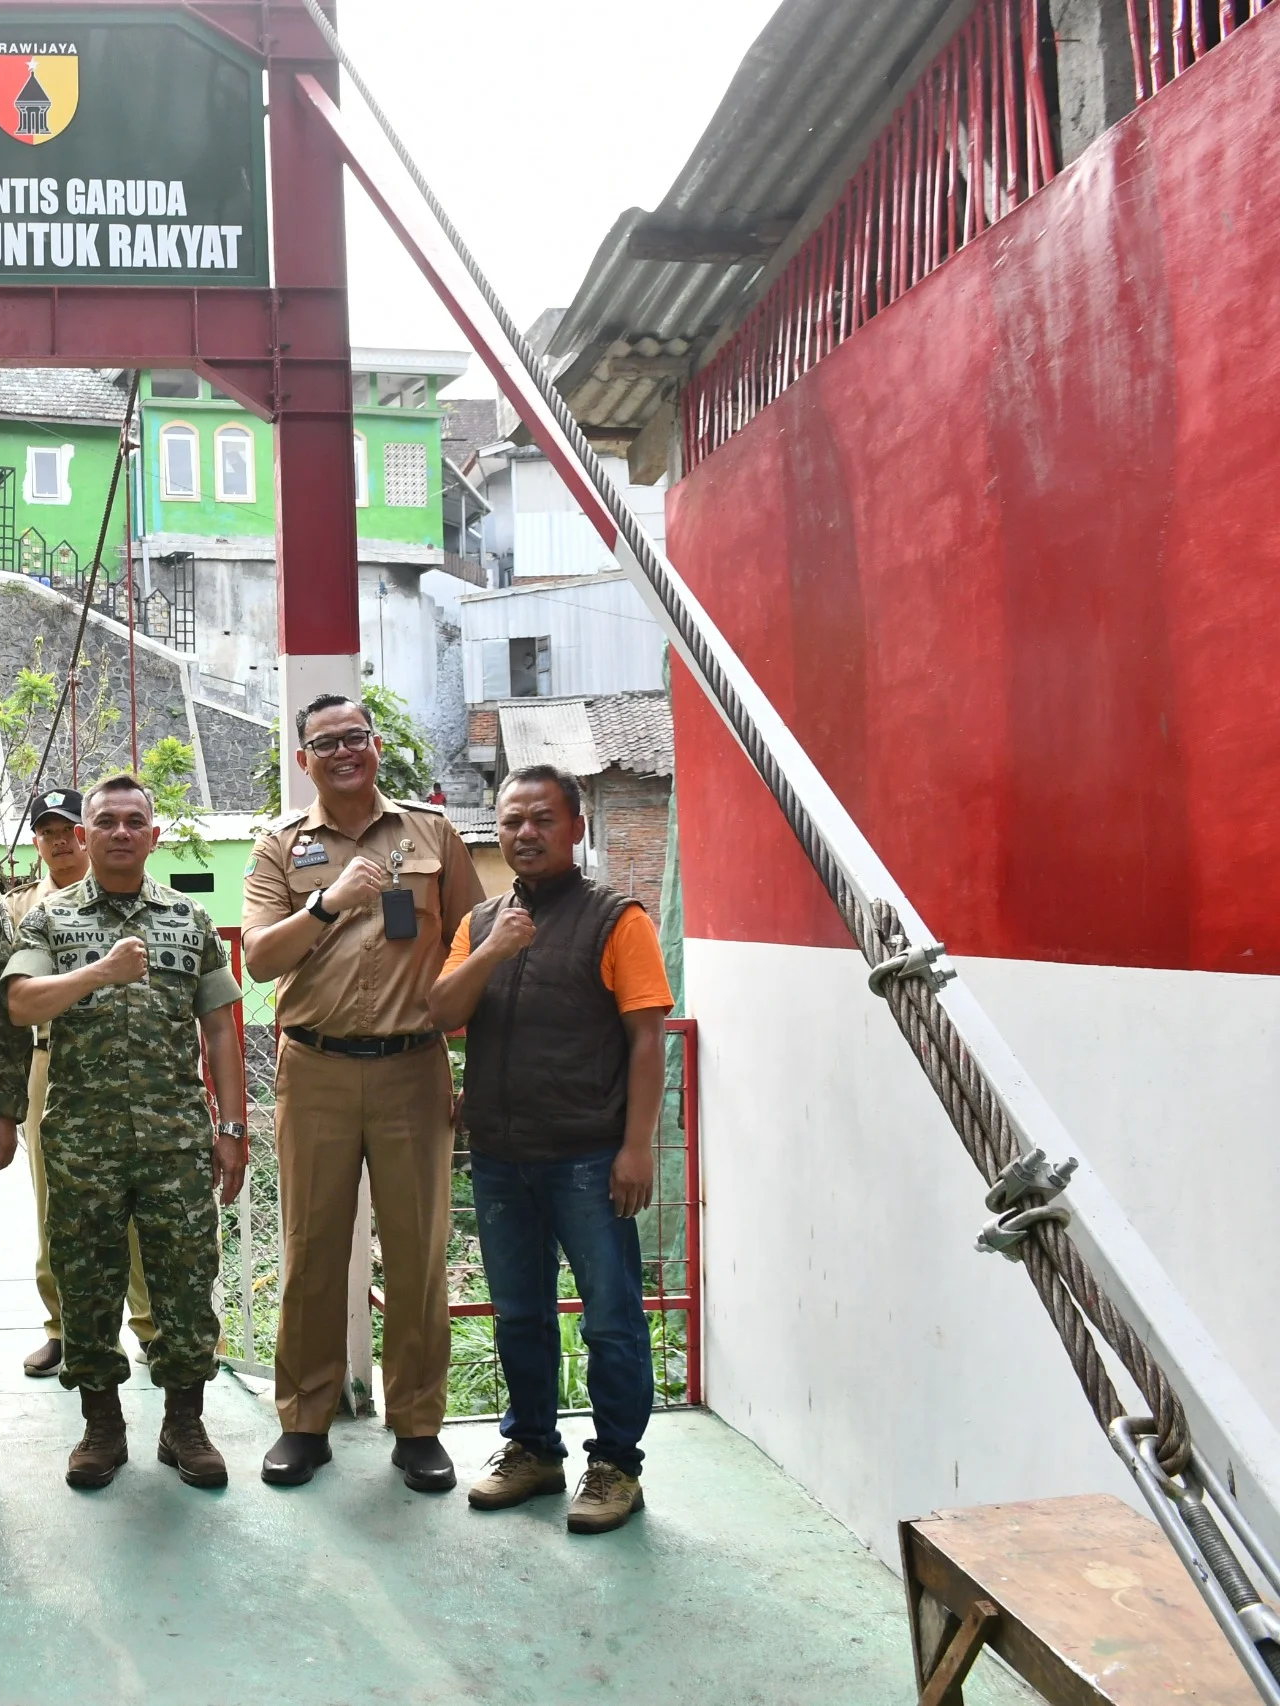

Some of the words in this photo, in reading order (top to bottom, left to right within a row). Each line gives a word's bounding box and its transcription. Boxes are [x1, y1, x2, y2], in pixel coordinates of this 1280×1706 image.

[66, 178, 188, 216] GARUDA
[109, 223, 243, 269] RAKYAT
[52, 931, 105, 946] WAHYU
[152, 932, 177, 942] TNI
[182, 933, 200, 946] AD
